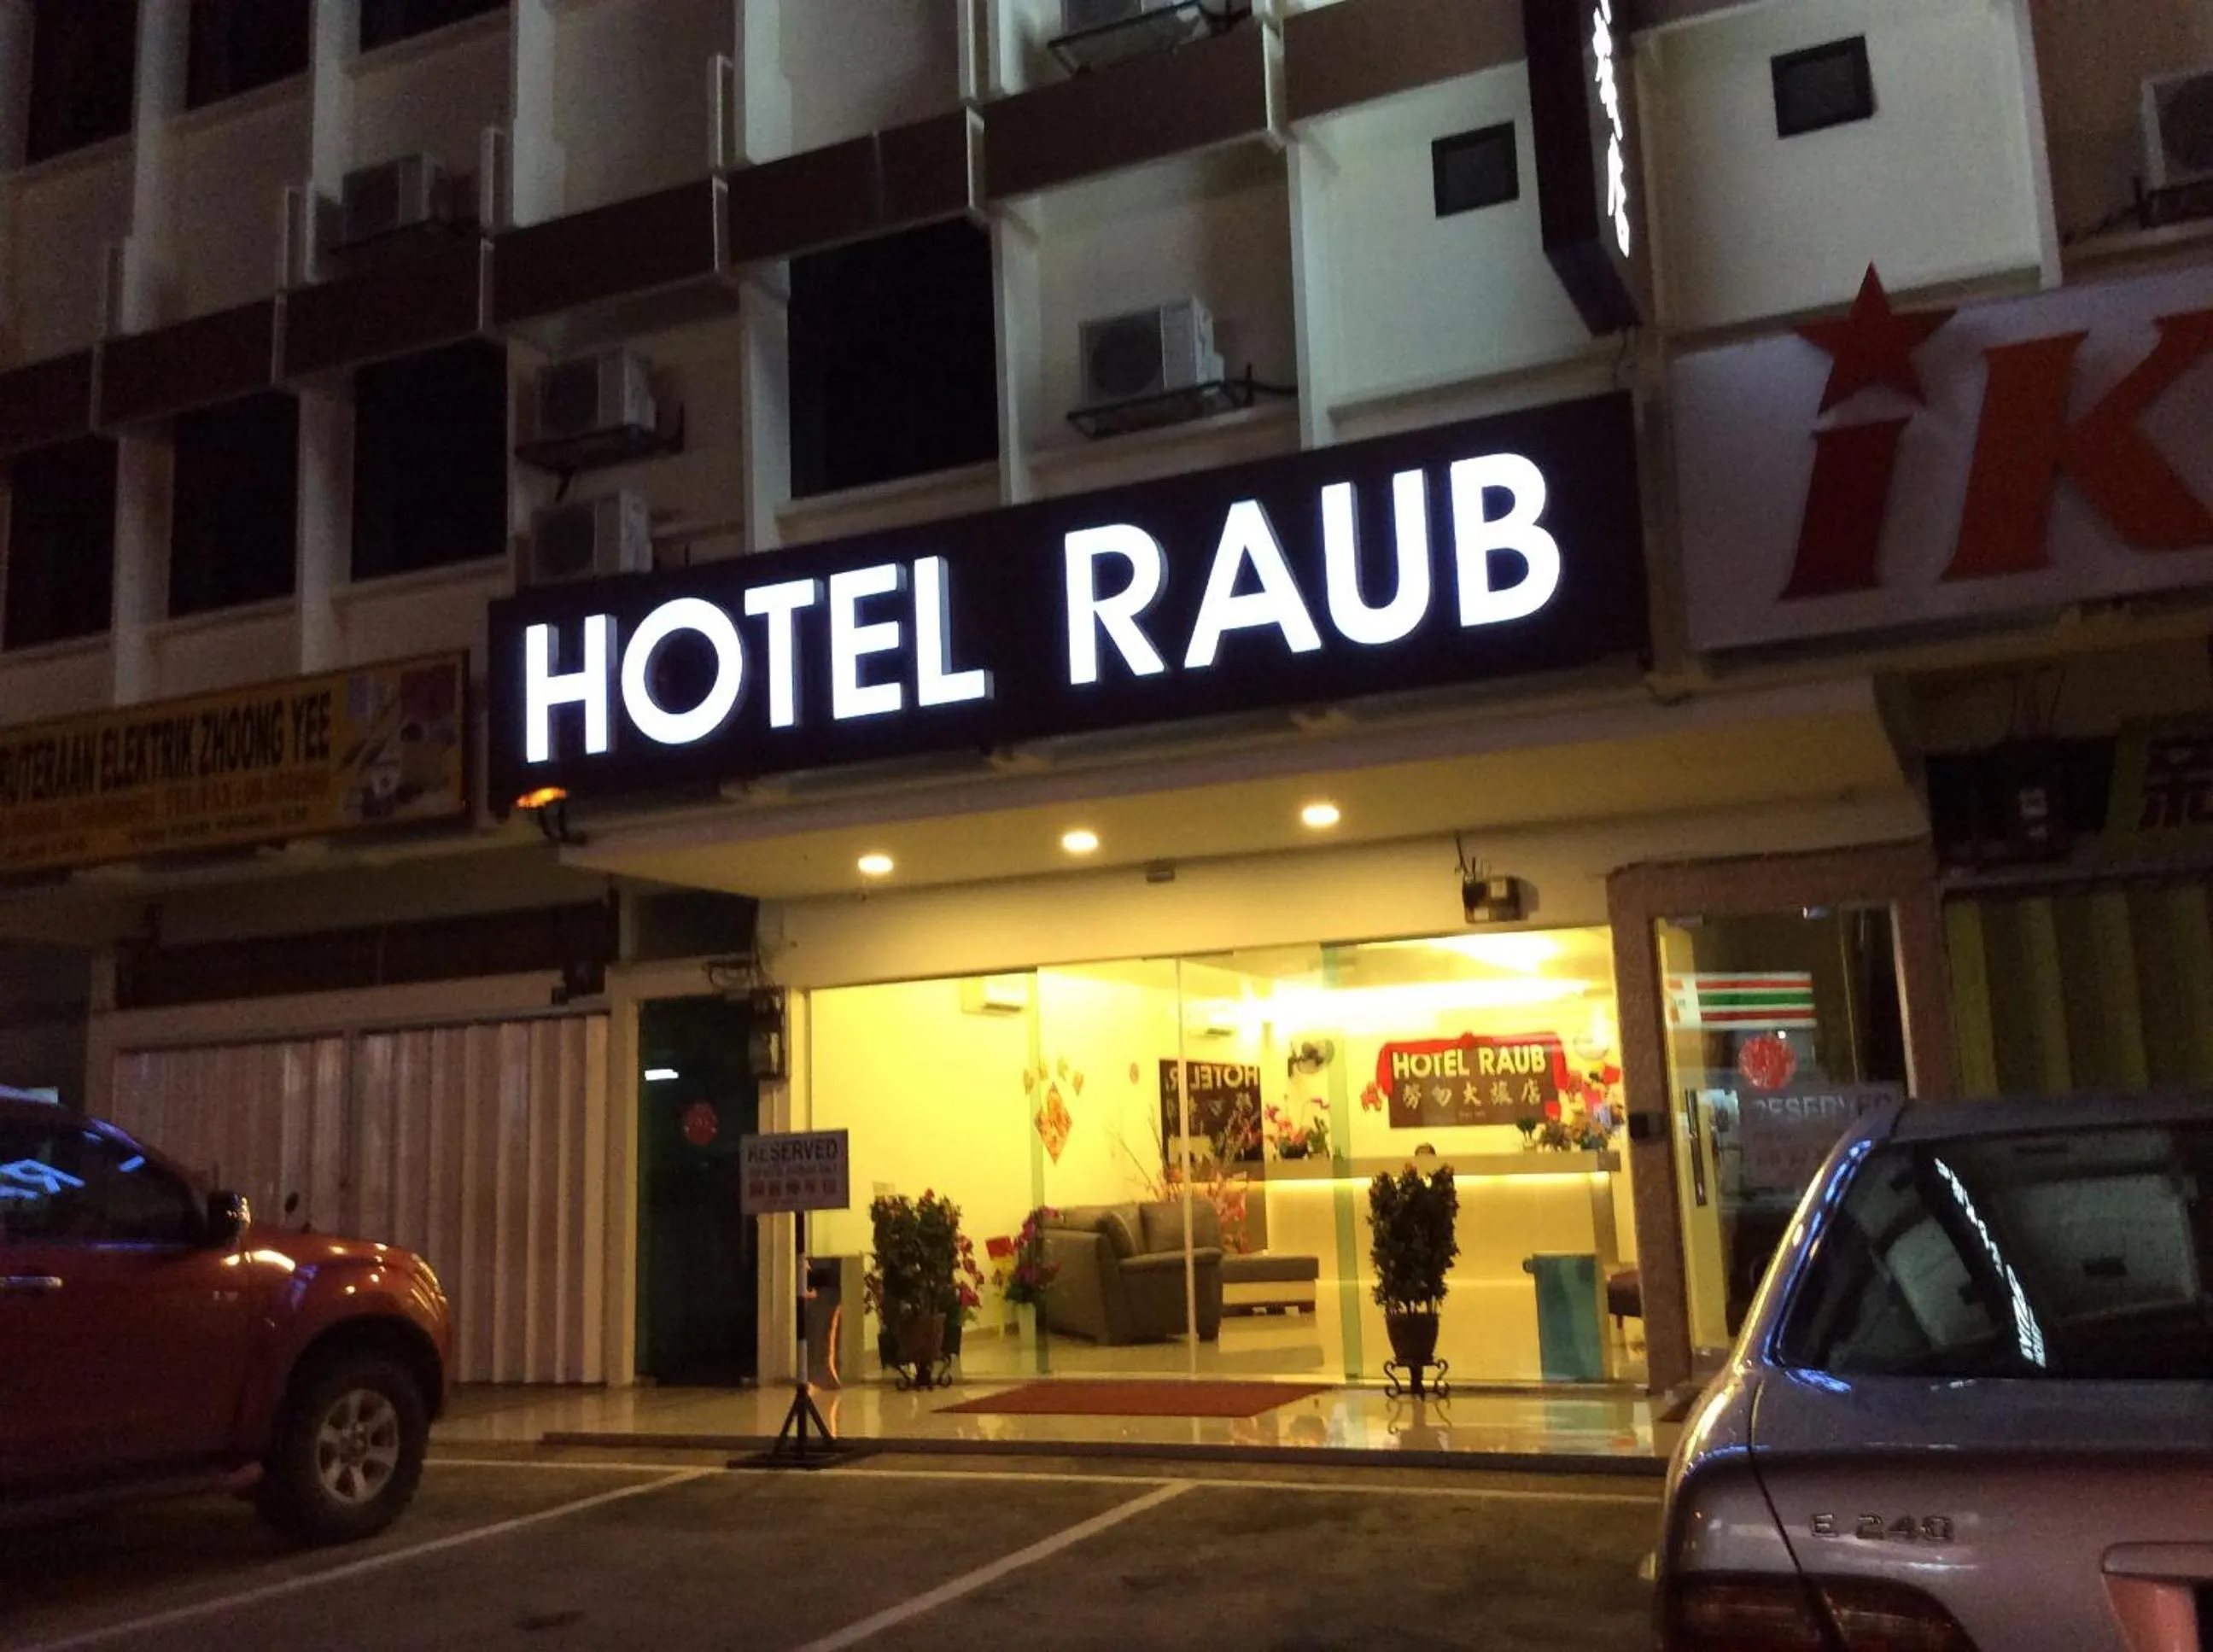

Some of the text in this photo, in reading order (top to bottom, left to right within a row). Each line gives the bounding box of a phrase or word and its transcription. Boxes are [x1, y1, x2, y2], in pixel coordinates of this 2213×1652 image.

[524, 452, 1562, 762] HOTEL RAUB
[292, 691, 331, 761] YEE
[1393, 1044, 1546, 1079] HOTEL RAUB
[748, 1137, 838, 1162] RESERVED
[1811, 1513, 1836, 1538] E
